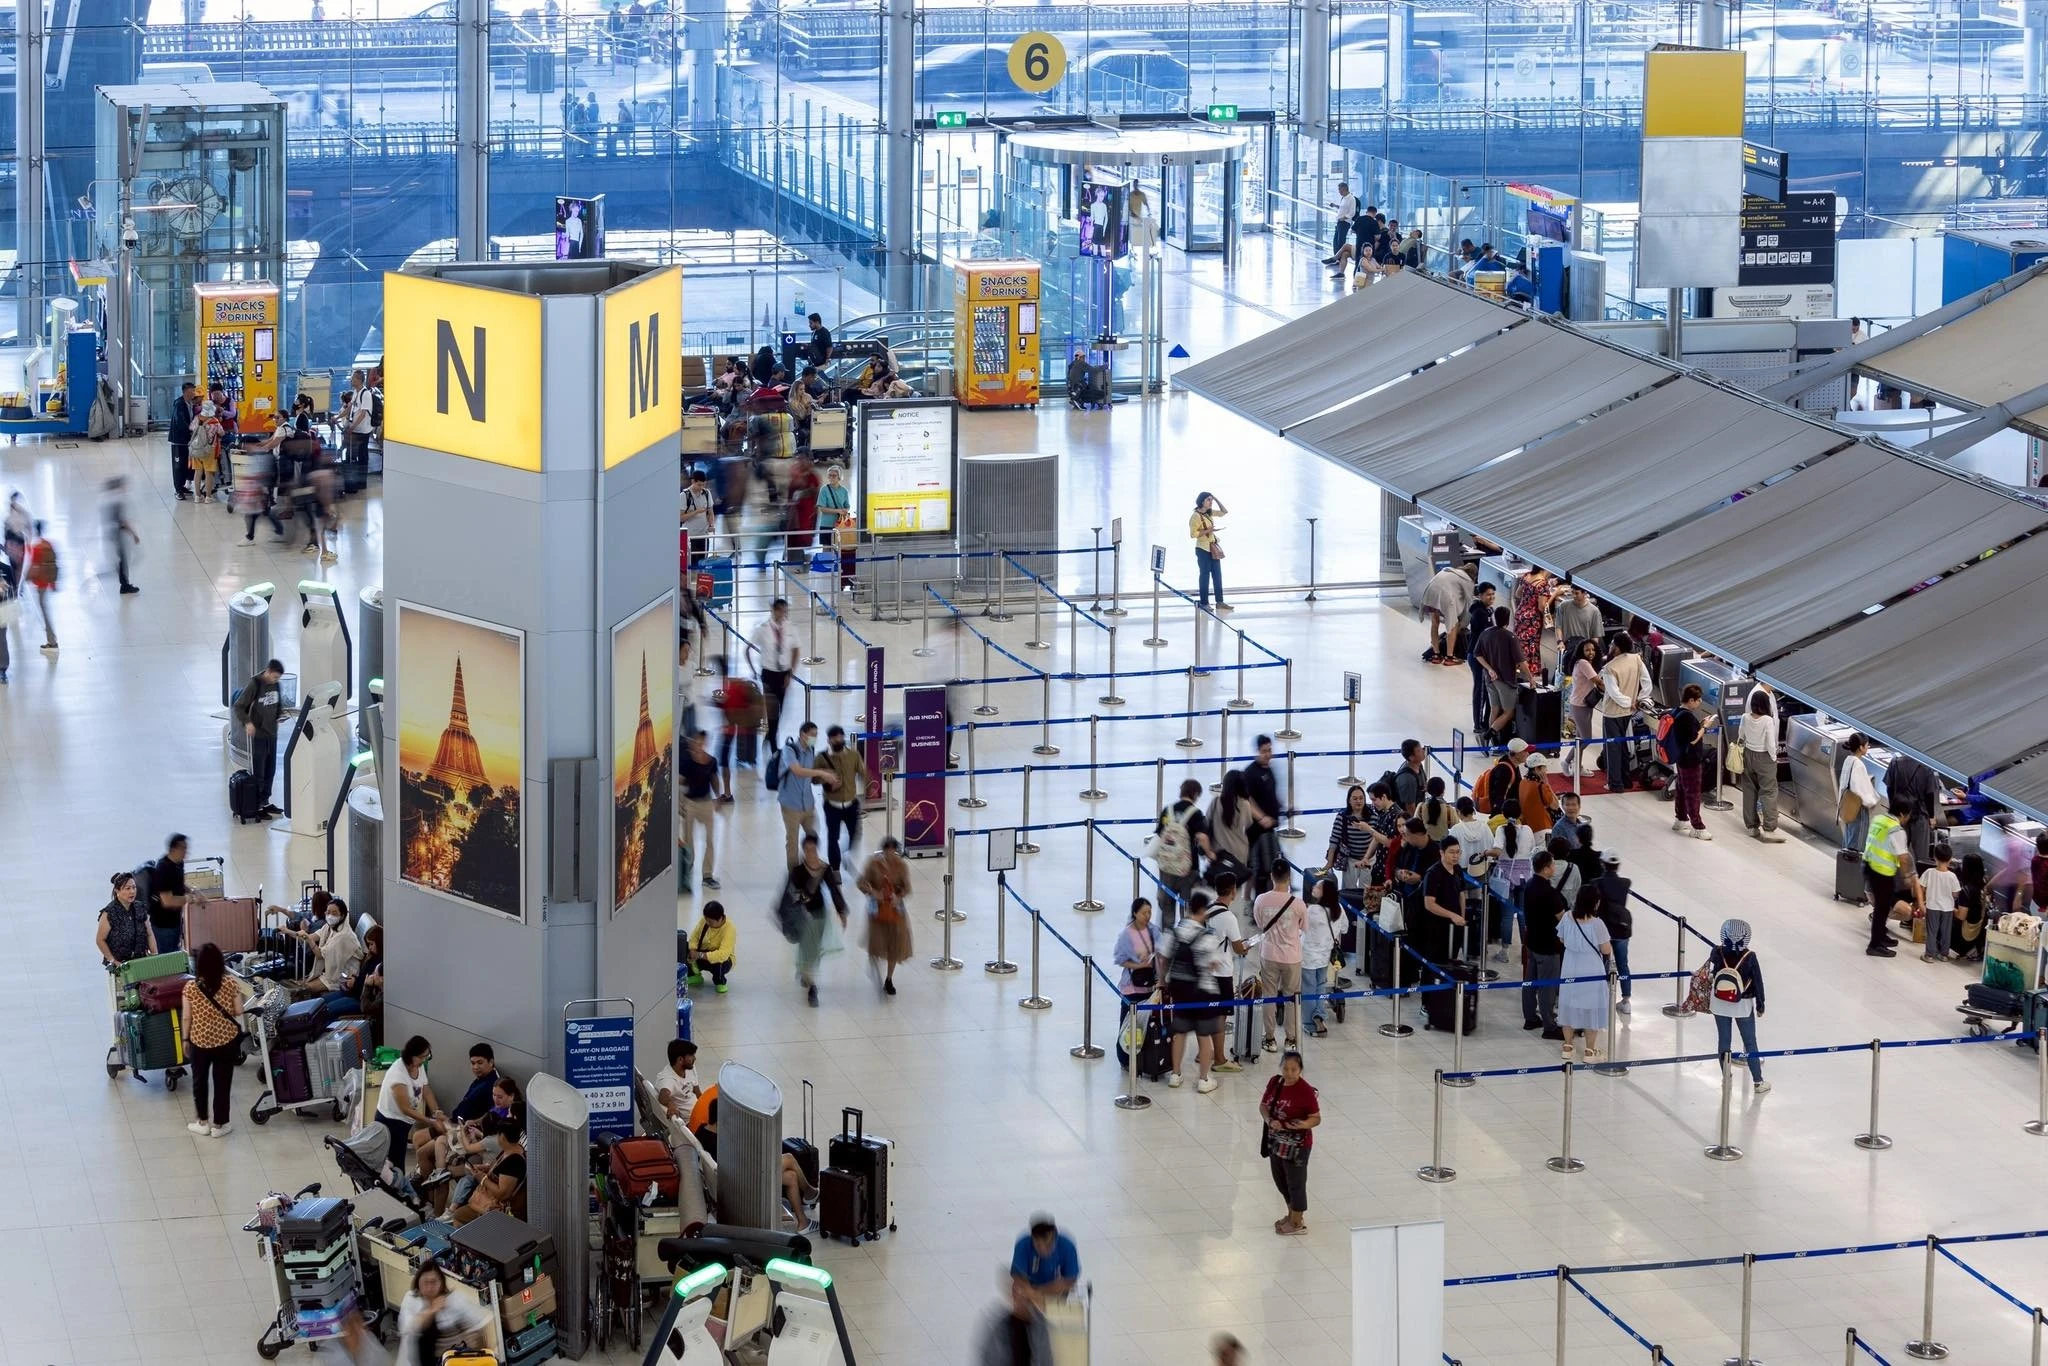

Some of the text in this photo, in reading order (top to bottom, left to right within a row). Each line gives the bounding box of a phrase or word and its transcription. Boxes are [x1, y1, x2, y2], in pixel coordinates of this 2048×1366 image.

[1025, 42, 1049, 82] 6
[1162, 154, 1168, 165] 6
[1769, 156, 1778, 167] A-K
[981, 276, 1027, 286] SNACKS
[992, 287, 1027, 296] DRINKS
[216, 301, 265, 312] SNACKS
[228, 313, 265, 321] DRINKS
[436, 318, 487, 424] N
[628, 312, 660, 420] M
